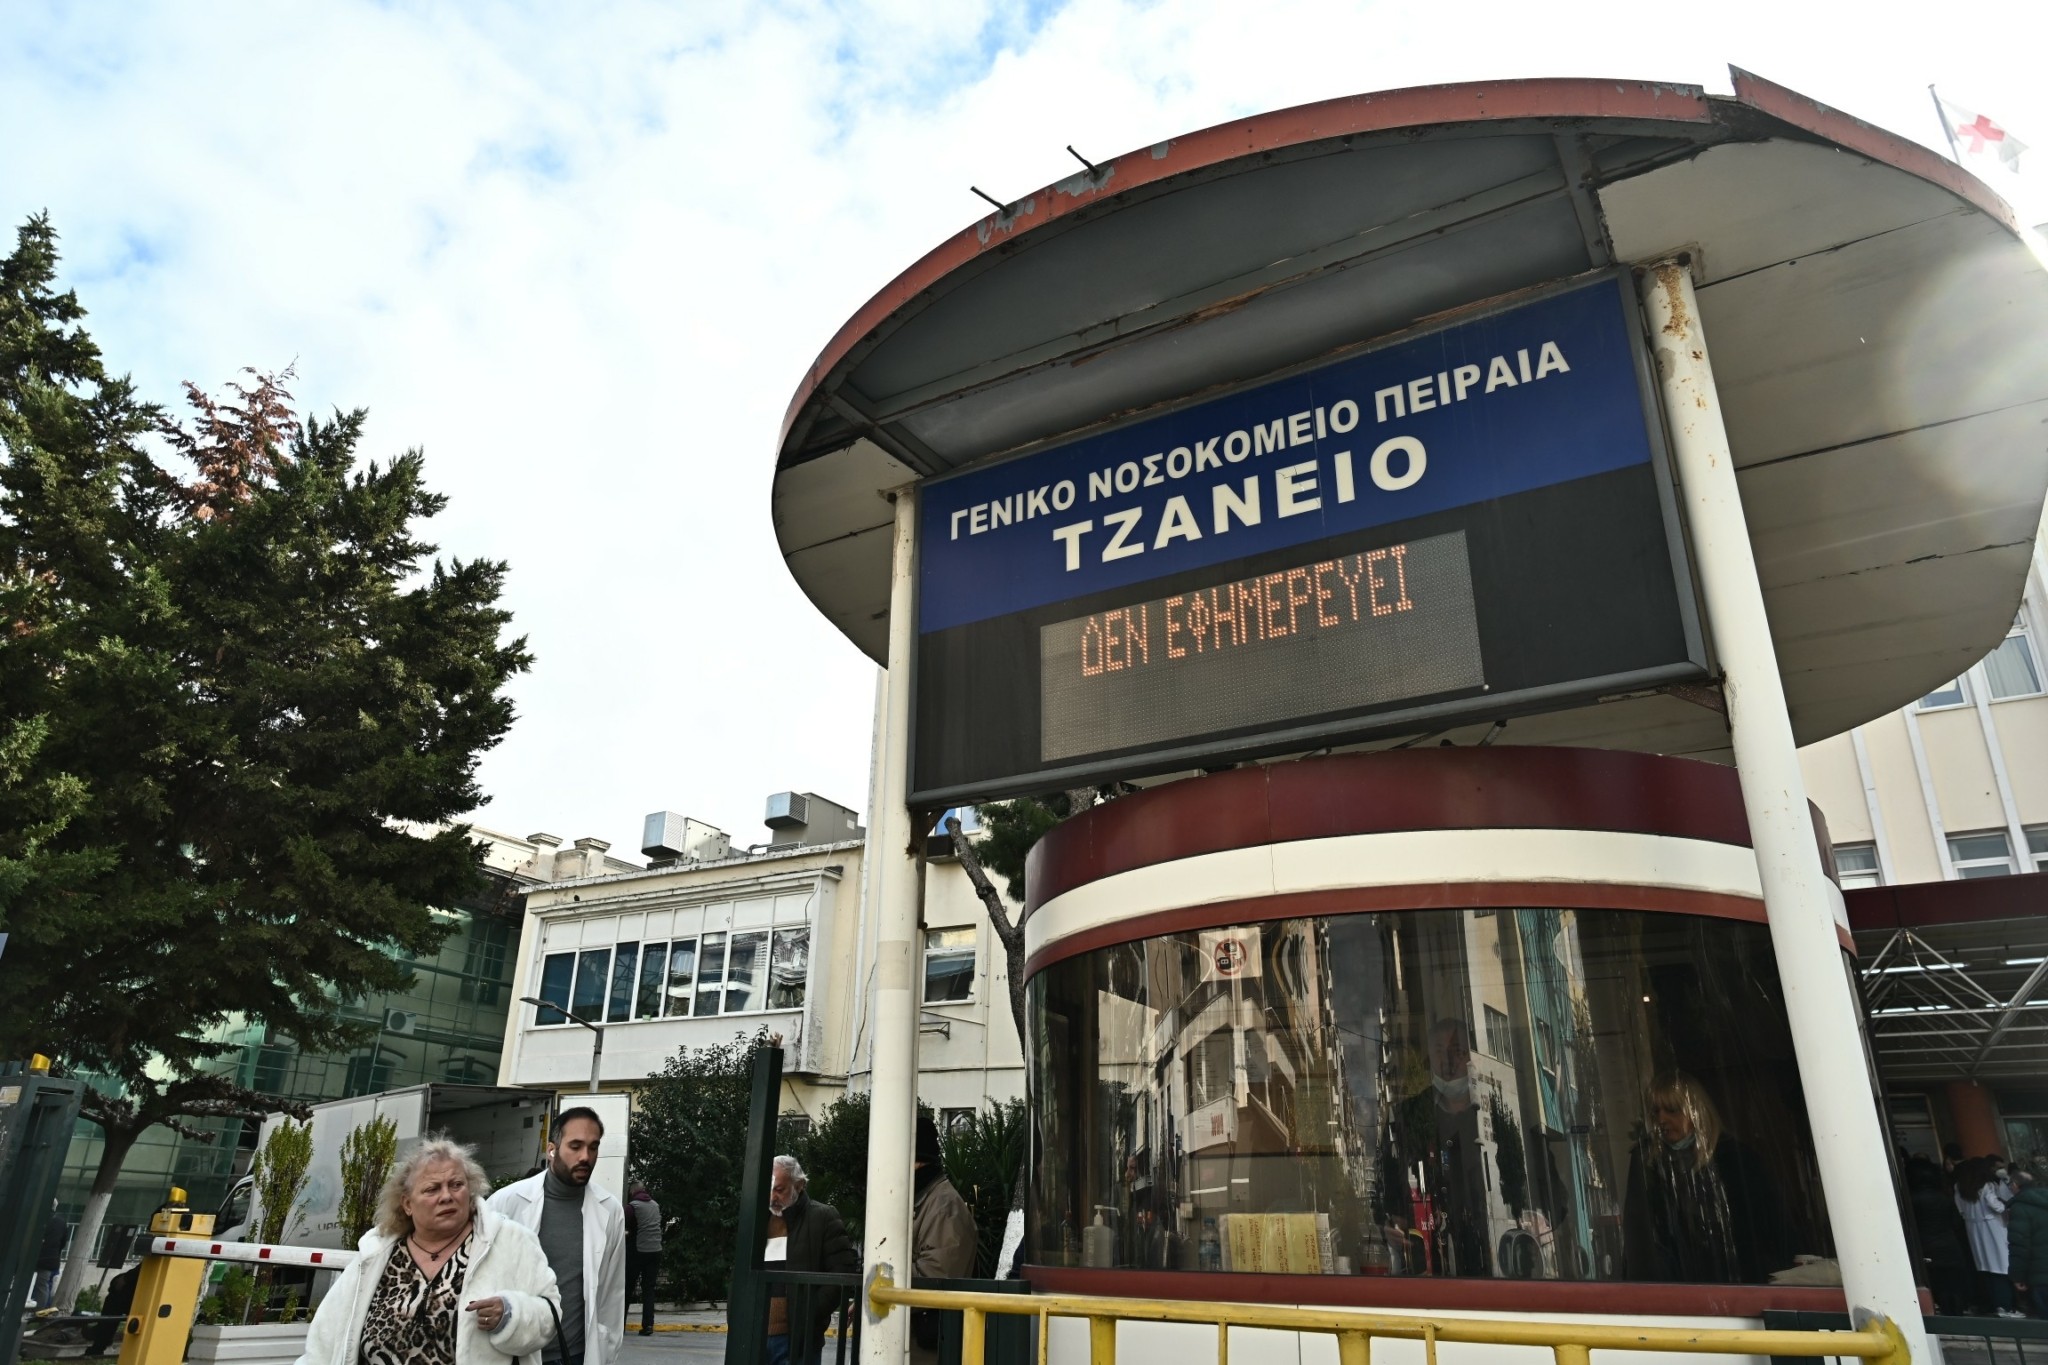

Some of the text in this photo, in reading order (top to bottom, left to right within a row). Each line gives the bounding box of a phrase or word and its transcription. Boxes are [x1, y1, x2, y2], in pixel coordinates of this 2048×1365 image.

[950, 341, 1570, 541] ΓΕΝΙΚΟ ΝΟΣΟΚΟΜΕΙΟ ΠΕΙΡΑΙΑ
[1052, 436, 1427, 572] ΤΖΑΝΕΙΟ
[1081, 543, 1413, 677] ΔΕΝ ΕΦΗΜΕΡΕΥΕΙ
